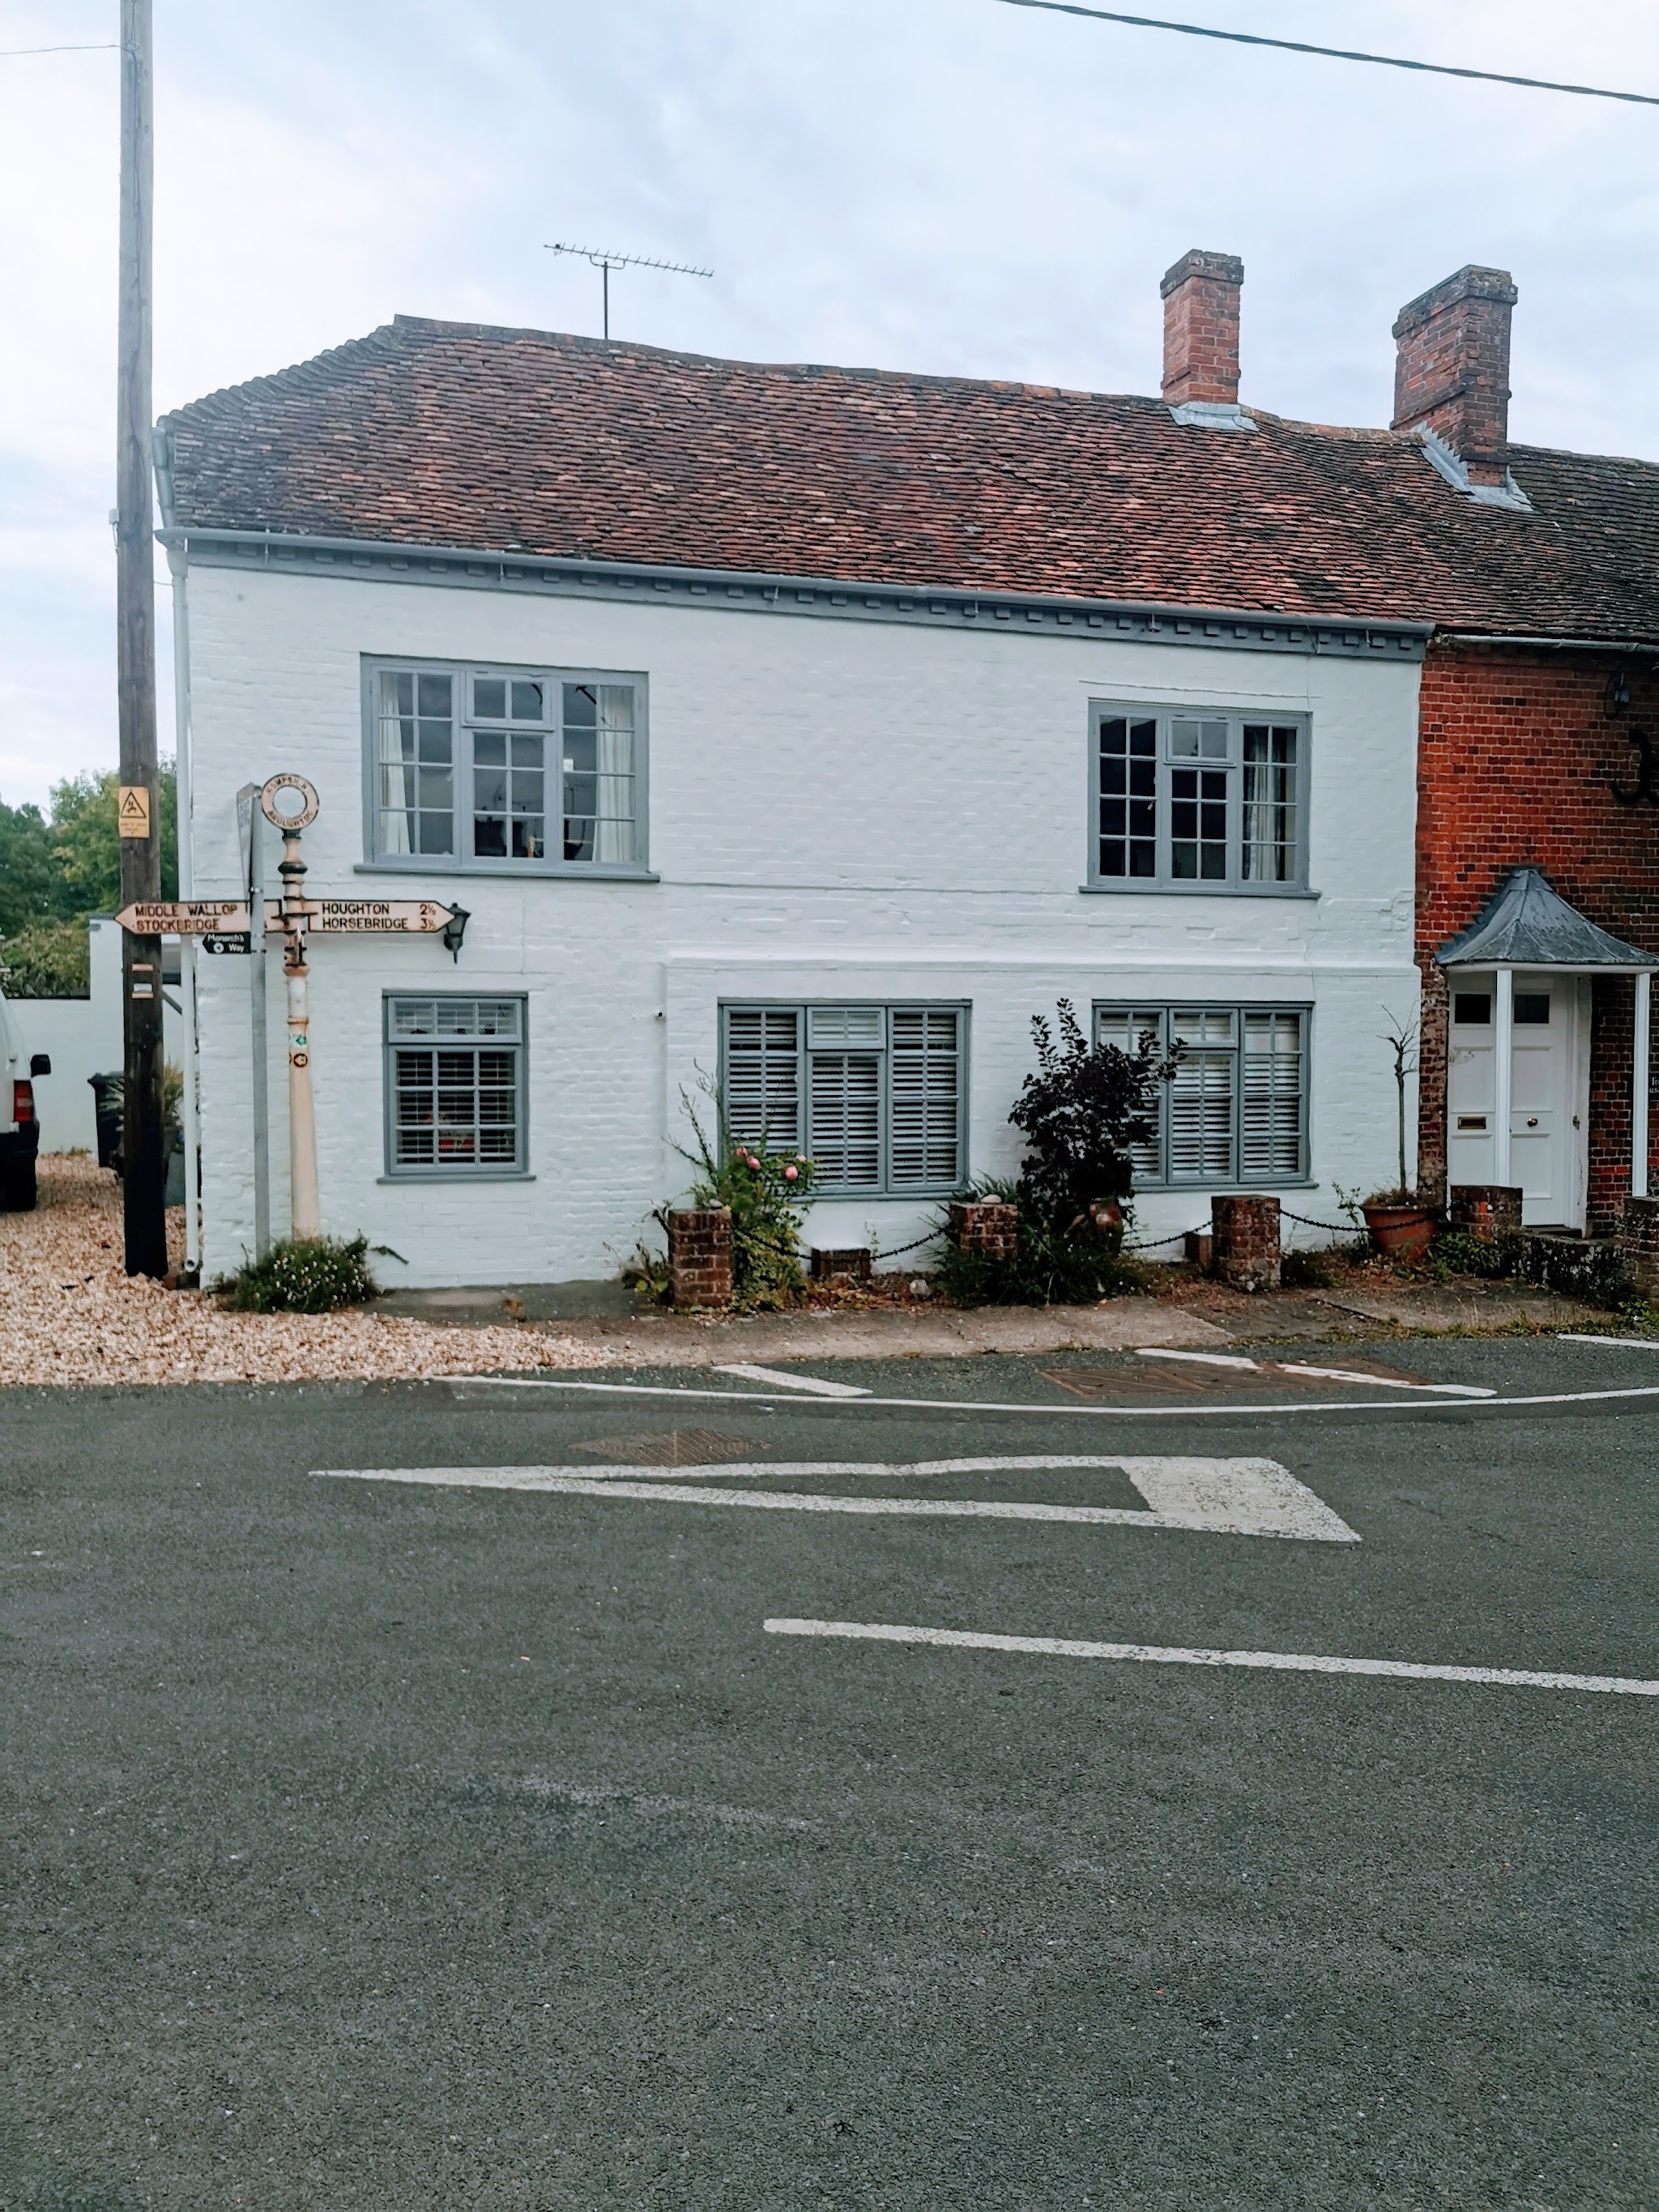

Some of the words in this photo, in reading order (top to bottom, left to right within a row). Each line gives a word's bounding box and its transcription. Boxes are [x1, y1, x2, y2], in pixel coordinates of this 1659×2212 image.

[134, 905, 179, 917] MIDDLE
[187, 905, 237, 917] WALLOP
[322, 903, 389, 914] HOUGHTON
[136, 918, 220, 931] STOCKBRIDGE
[322, 917, 408, 930] HORSEBRIDGE
[207, 934, 245, 943] Monarch's
[228, 944, 245, 953] Way
